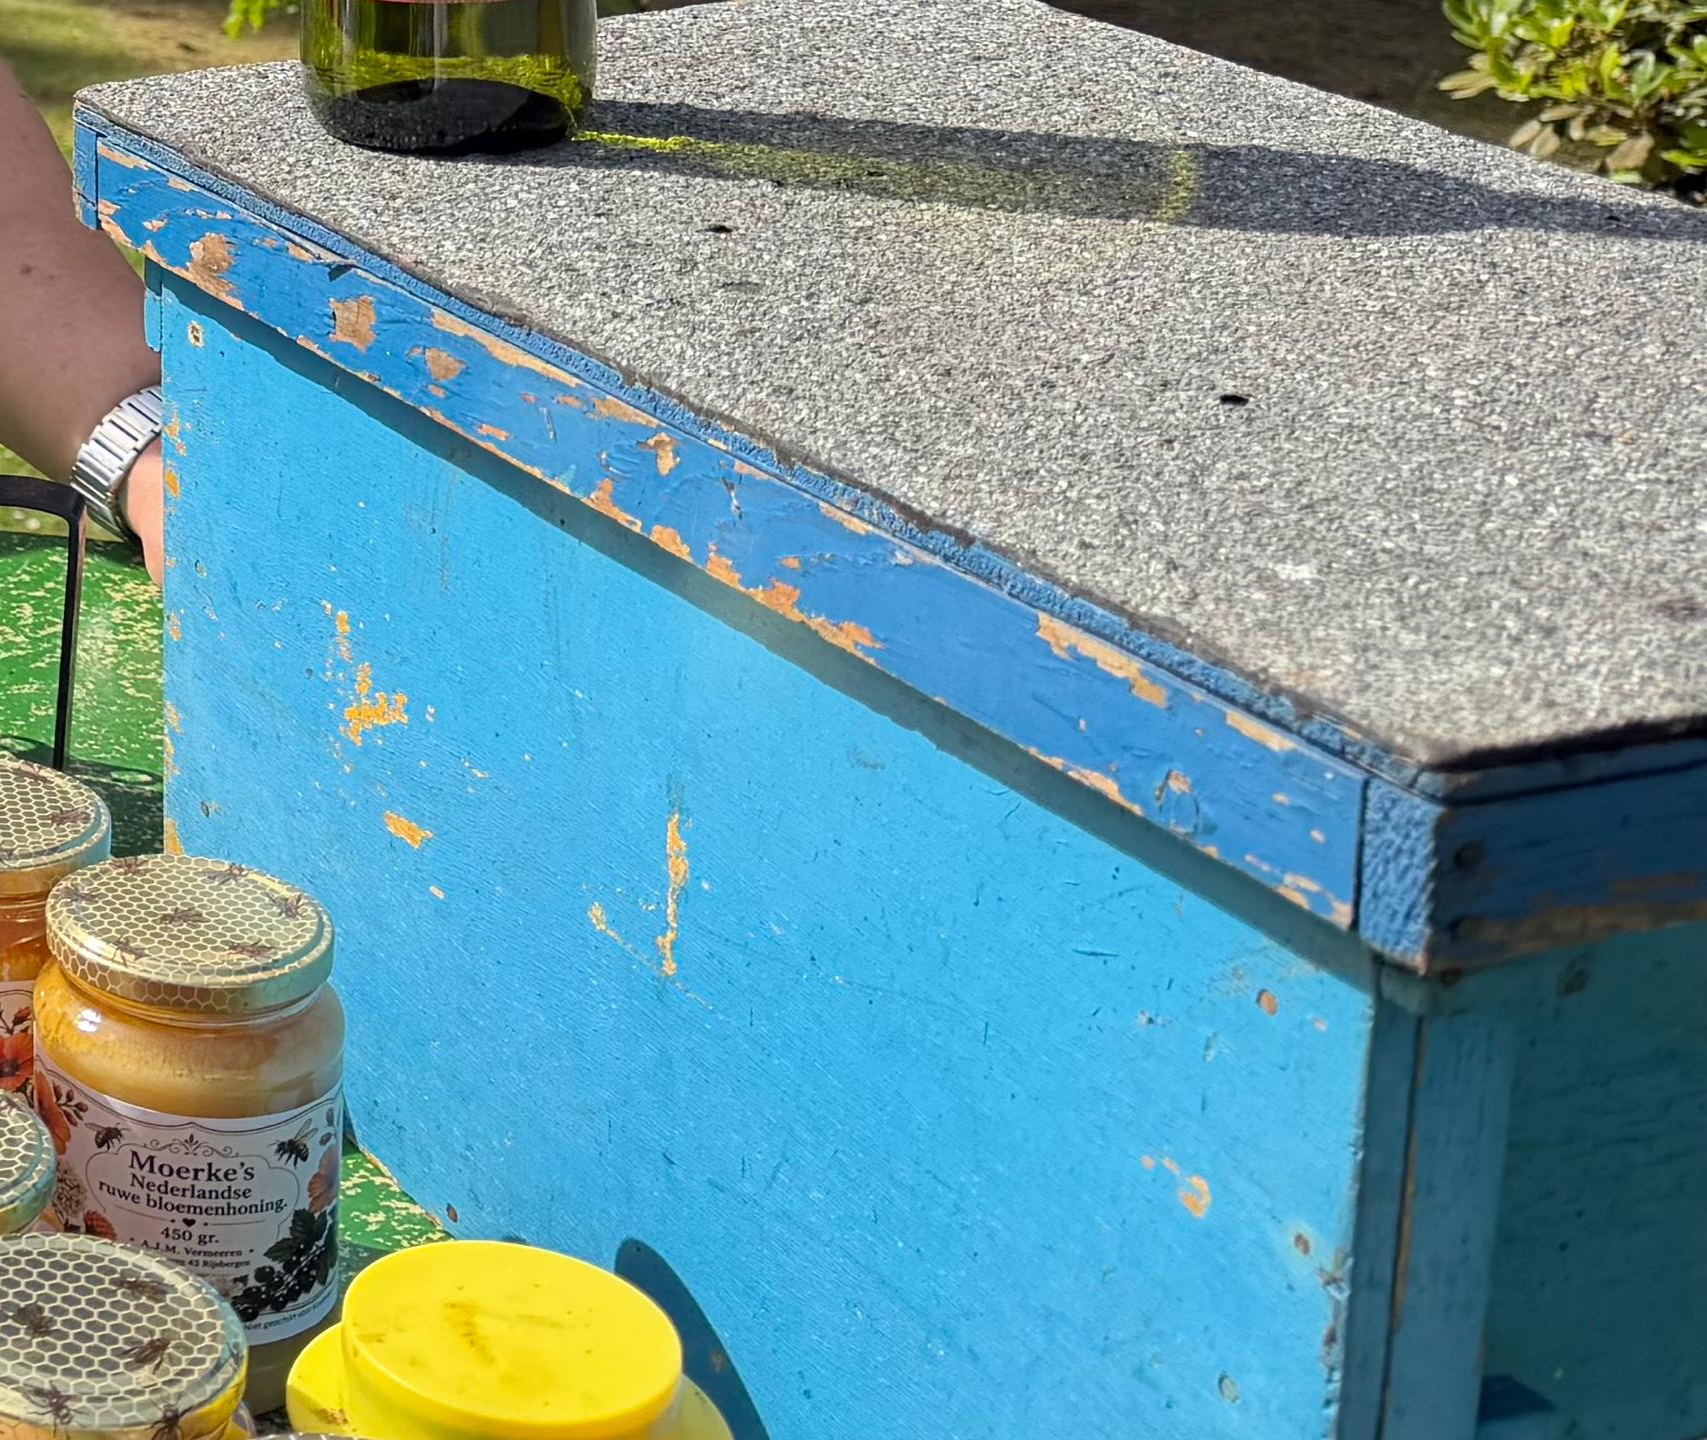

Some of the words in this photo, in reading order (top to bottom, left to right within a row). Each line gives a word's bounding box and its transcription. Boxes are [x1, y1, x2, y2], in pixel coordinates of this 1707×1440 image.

[128, 1149, 255, 1182] Moerke's
[98, 1180, 140, 1204] ruwe
[146, 1193, 288, 1216] bloemenhoning.
[130, 1173, 252, 1200] Nederlandse
[161, 1226, 192, 1242] 450
[197, 1233, 220, 1246] gr.
[184, 1247, 243, 1258] Vermeeren
